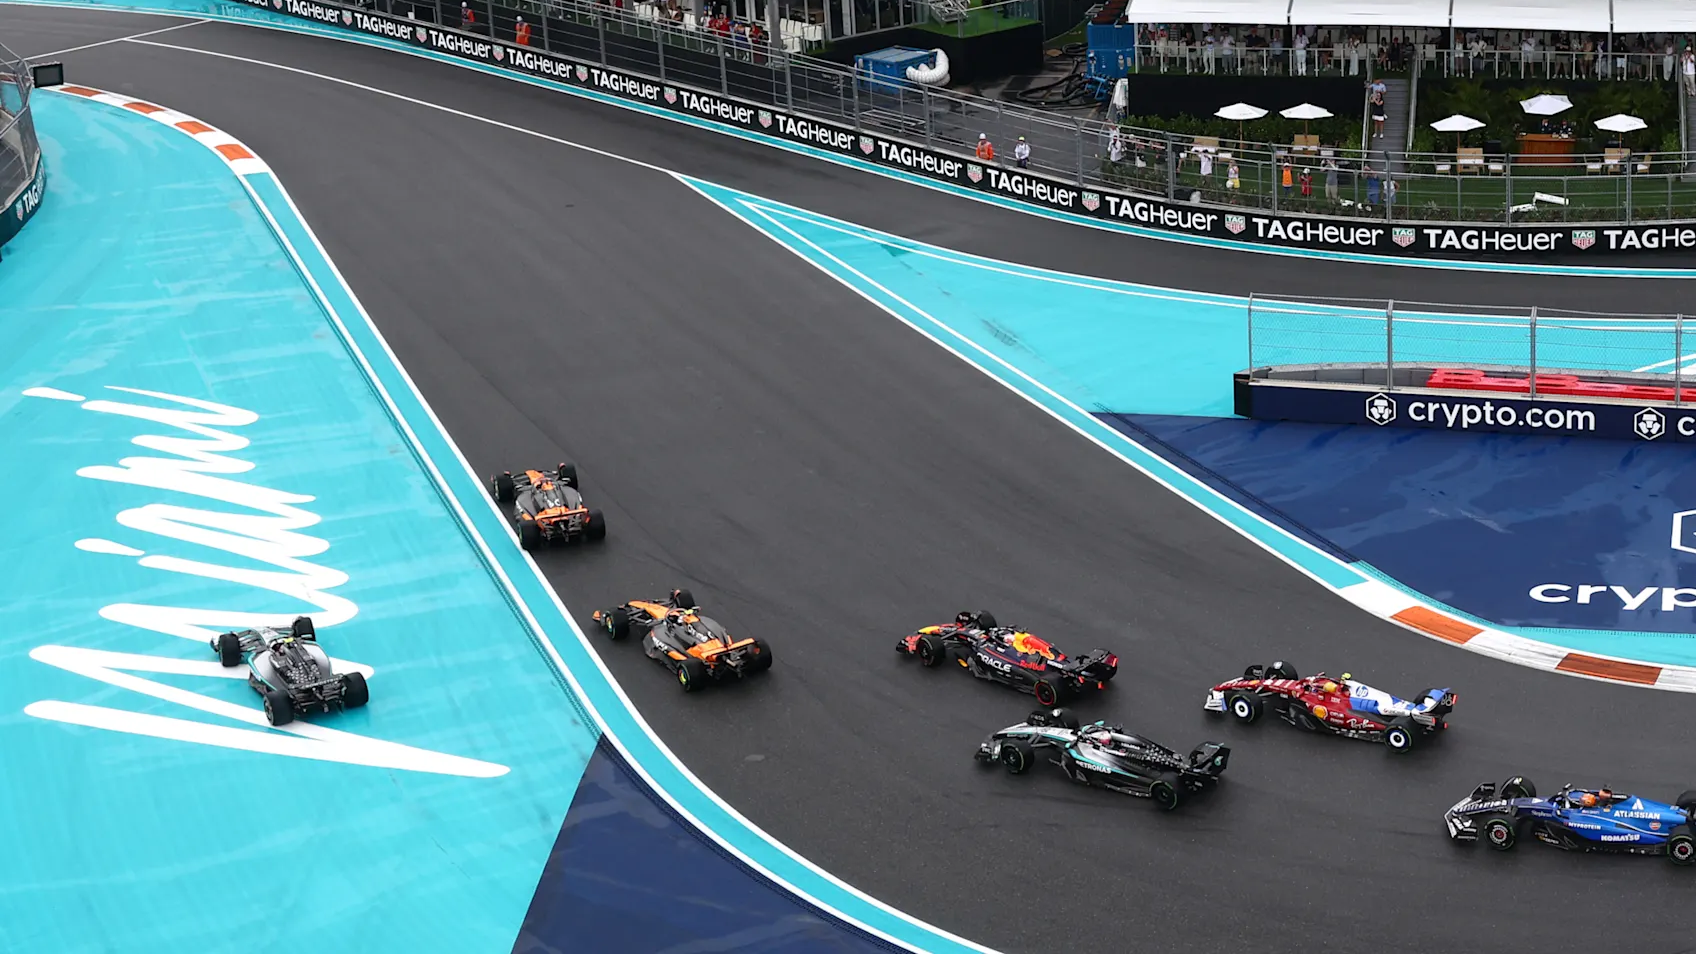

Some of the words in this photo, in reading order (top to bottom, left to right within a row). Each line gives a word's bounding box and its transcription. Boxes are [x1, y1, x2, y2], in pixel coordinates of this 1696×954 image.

[354, 13, 413, 40] TAGHeuer
[429, 30, 491, 58] TAGHeuer
[506, 48, 573, 79] TAGHeuer
[591, 69, 660, 100] TAGHeuer
[680, 90, 755, 124] TAGHeuer
[776, 114, 855, 150] TAGHeuer
[878, 140, 962, 178] TAGHeuer
[987, 168, 1077, 208] TAGHeuer
[1082, 192, 1100, 201] TAG
[1105, 196, 1218, 231] TAGHeuer
[1225, 215, 1245, 224] TAG
[1252, 217, 1384, 246] TAGHeuer
[1393, 229, 1415, 237] TAG
[1423, 229, 1563, 251] TAGHeuer
[1573, 231, 1595, 239] TAG
[1408, 401, 1595, 431] crypto.com
[977, 652, 1012, 673] ORACLE
[1076, 760, 1111, 774] PETRONAS
[1614, 810, 1660, 820] ATLASSIAN
[1601, 834, 1640, 842] KOMATSU
